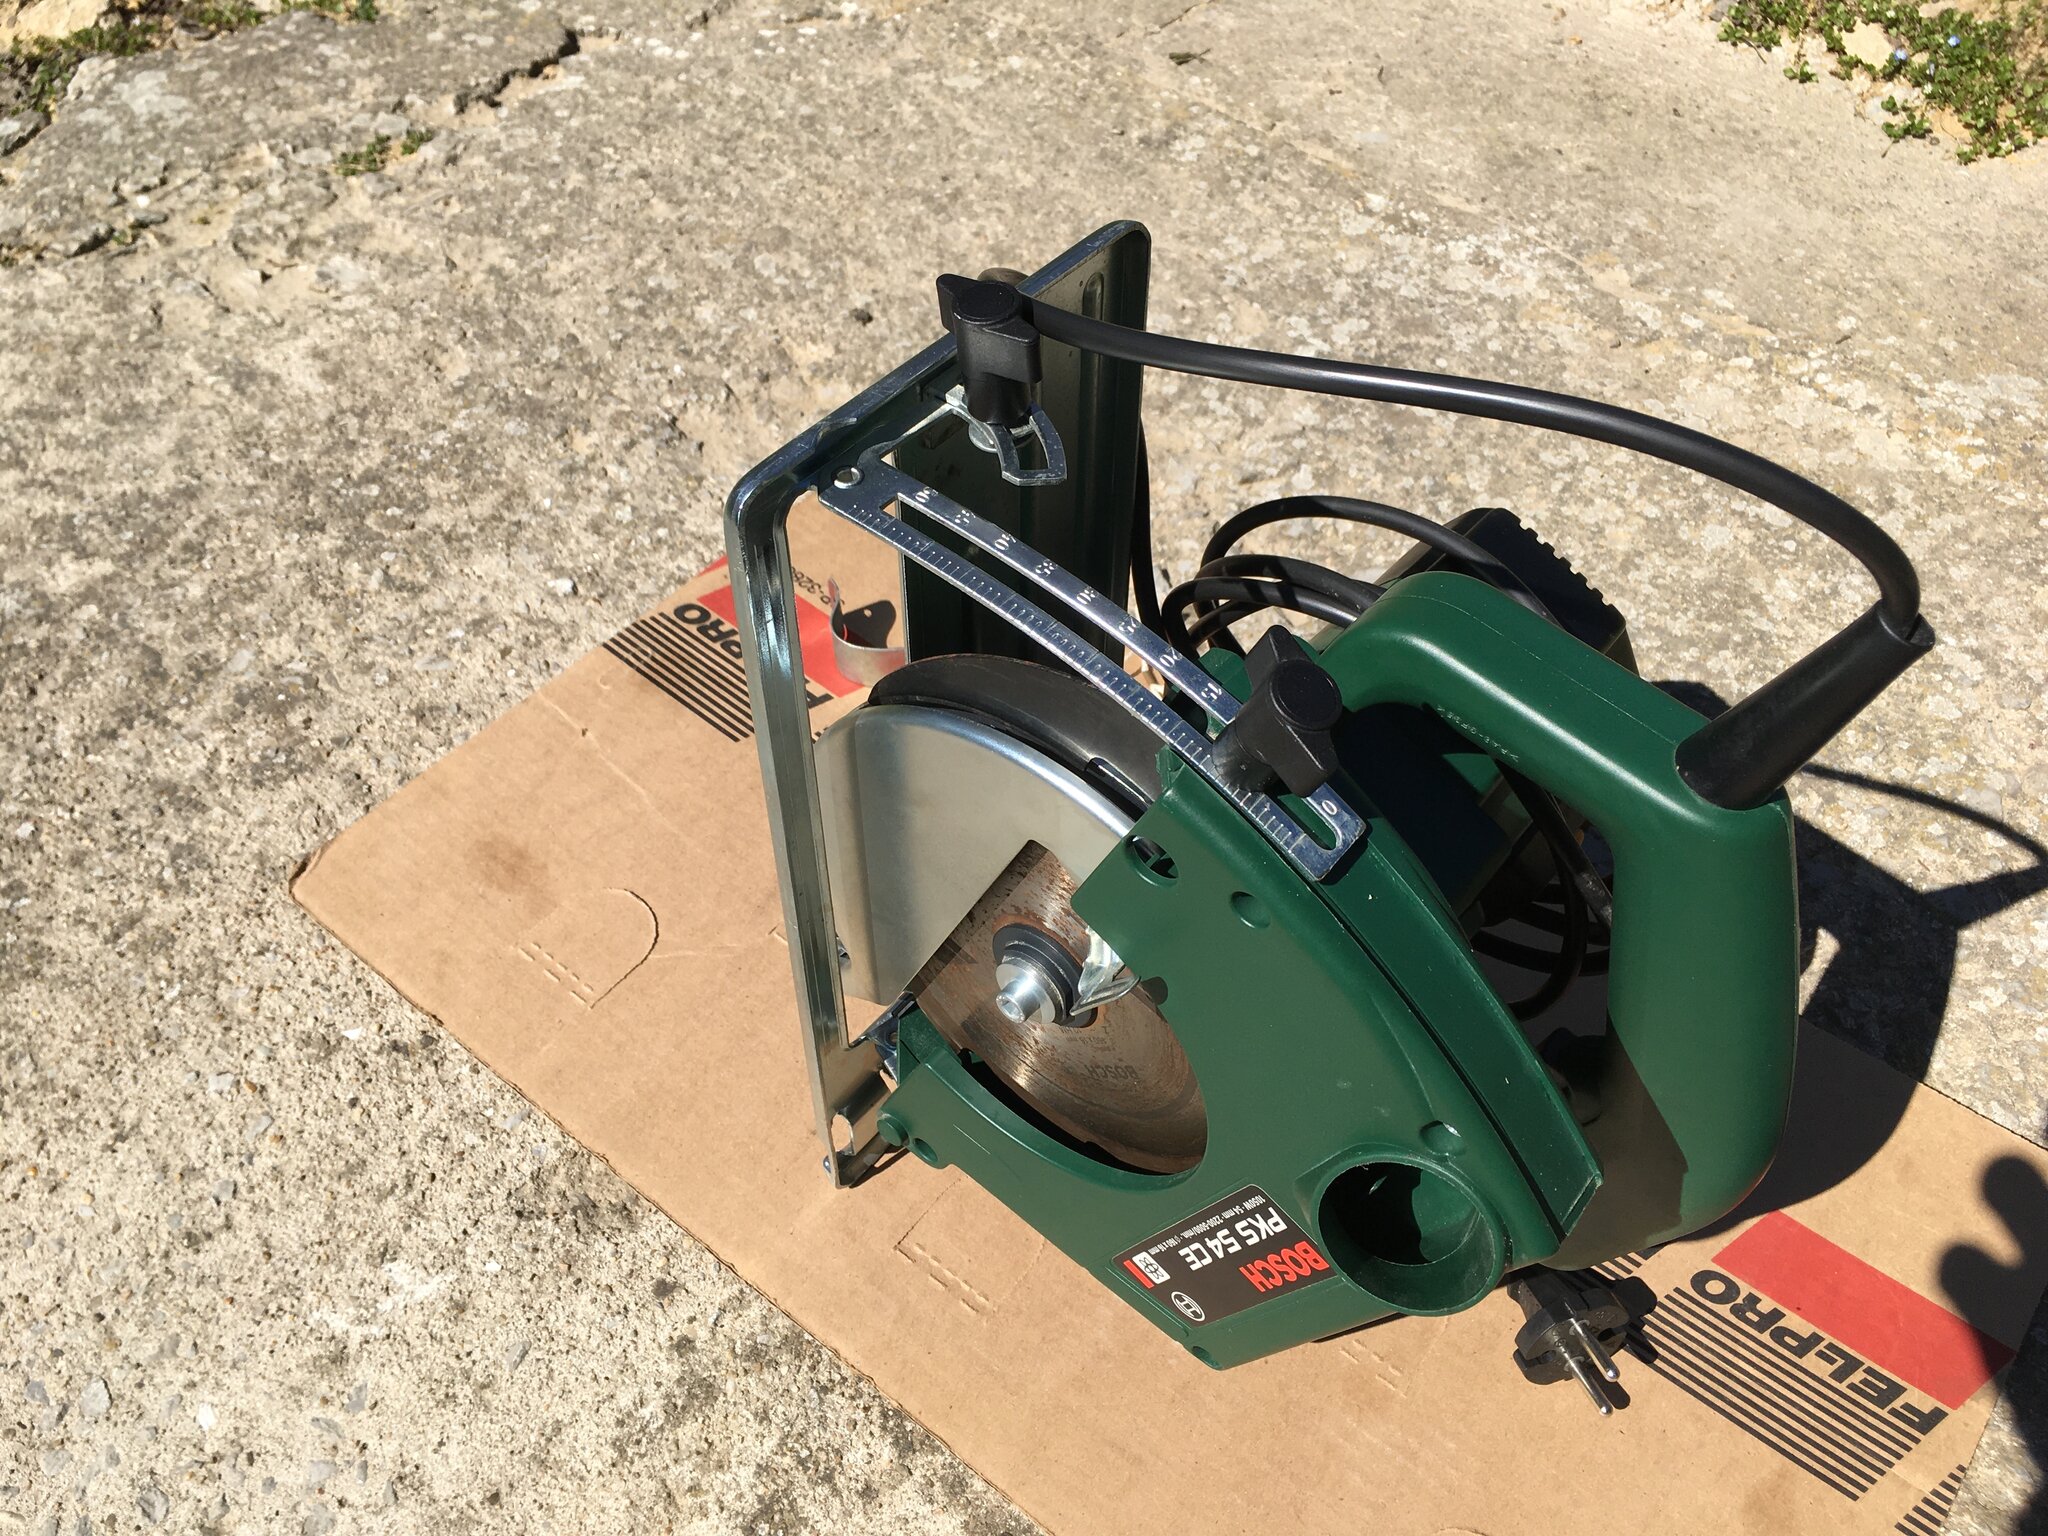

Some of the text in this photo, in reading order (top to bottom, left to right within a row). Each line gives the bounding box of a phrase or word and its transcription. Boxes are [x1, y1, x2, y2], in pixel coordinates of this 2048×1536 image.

[1159, 646, 1183, 668] 20
[1201, 682, 1222, 701] 15
[1321, 800, 1338, 816] 0
[1083, 1065, 1140, 1081] BOSCH
[1177, 1207, 1288, 1271] PKS 54 CE
[1239, 1241, 1330, 1293] BOSCH
[1690, 1269, 1949, 1436] FEL-PRO
